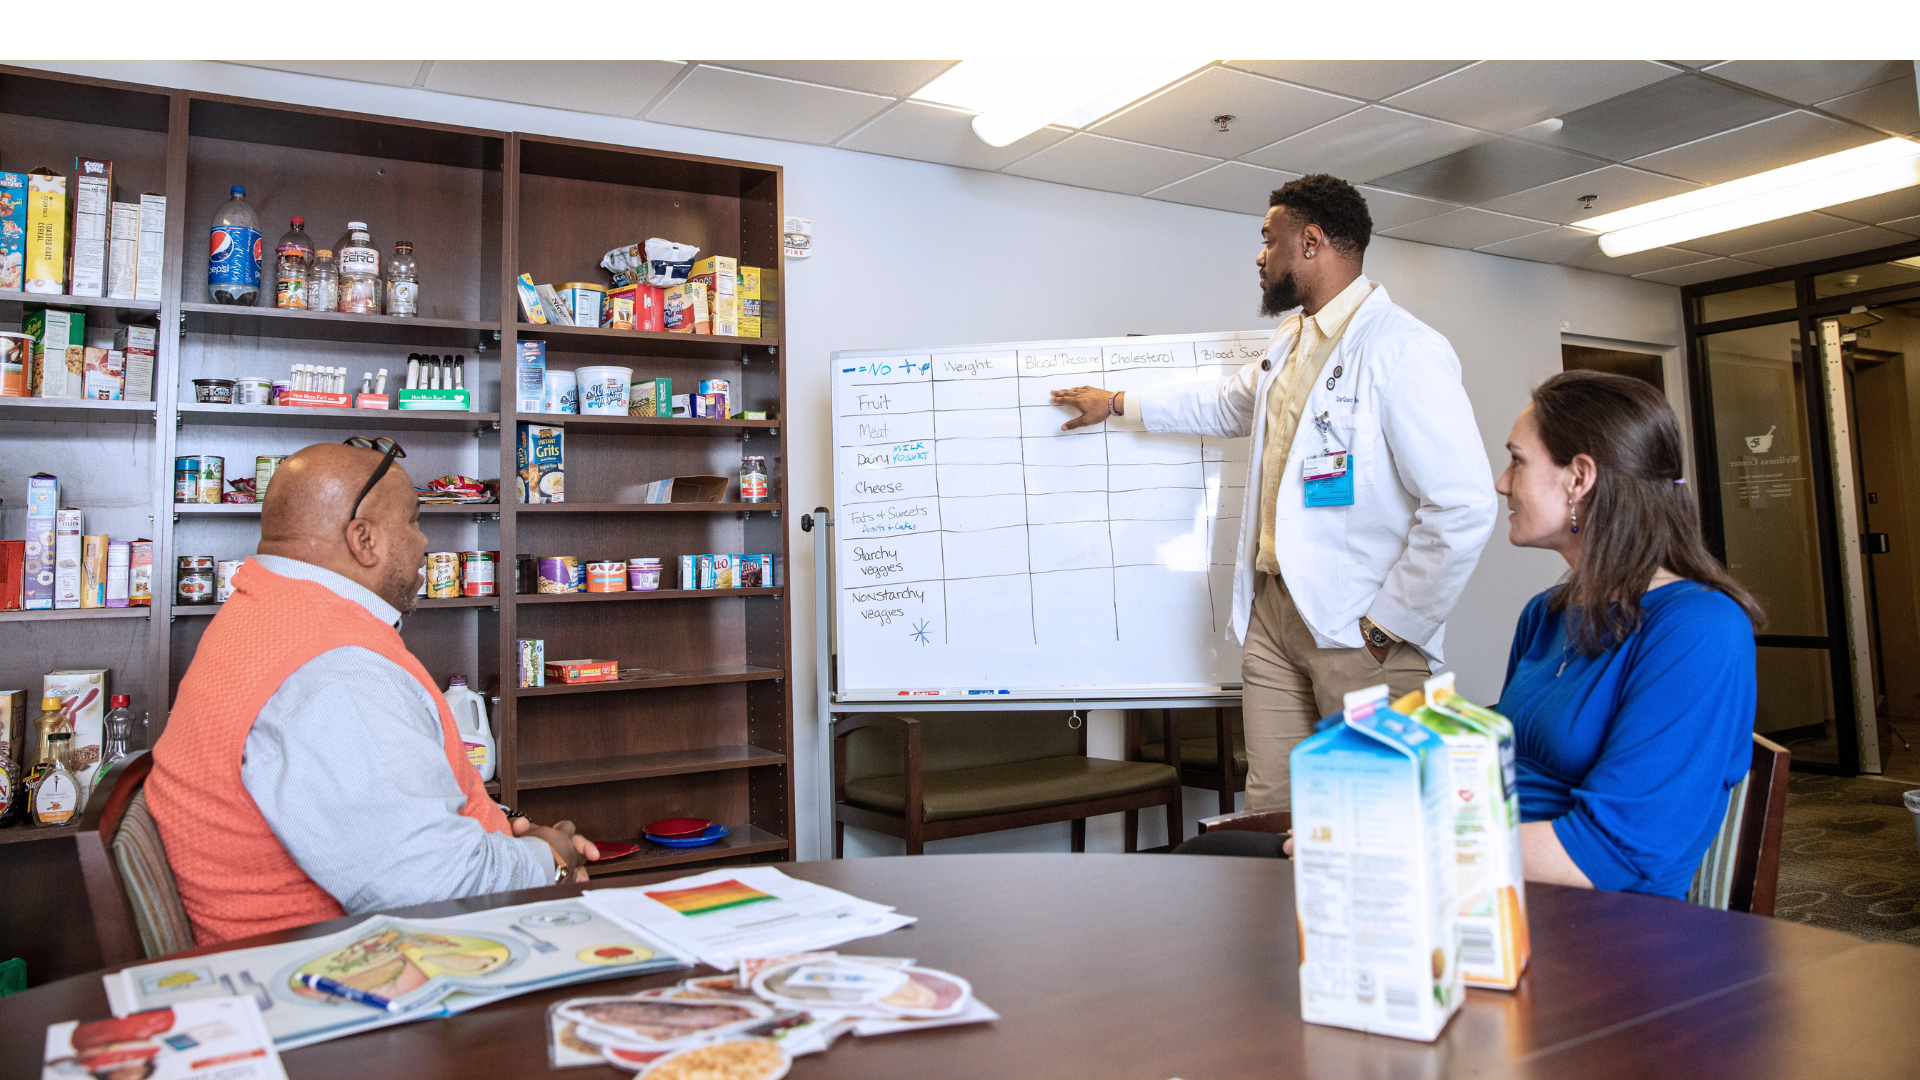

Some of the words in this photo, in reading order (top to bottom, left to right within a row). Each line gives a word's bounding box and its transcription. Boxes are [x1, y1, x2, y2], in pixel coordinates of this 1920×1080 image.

[343, 256, 374, 264] ZERO
[1025, 355, 1057, 370] Blood
[1061, 352, 1100, 365] Pressure
[1110, 349, 1174, 364] Cholesterol
[1200, 349, 1234, 360] Blood
[944, 358, 993, 376] Weight
[591, 384, 624, 398] Whipped
[712, 382, 728, 390] Dole
[856, 394, 892, 410] Fruit
[859, 423, 890, 438] Meat
[536, 444, 559, 458] Grits
[892, 442, 924, 452] MILK
[856, 454, 890, 466] Dairy
[892, 452, 929, 464] YOGURT
[855, 481, 904, 494] Cheese
[848, 511, 874, 524] Fats
[888, 505, 928, 520] Sweets
[895, 521, 916, 530] Cakes
[852, 546, 898, 562] Starchy
[714, 559, 728, 570] LL-O
[860, 562, 904, 578] veggies
[860, 608, 904, 627] veggies
[51, 688, 80, 697] Special
